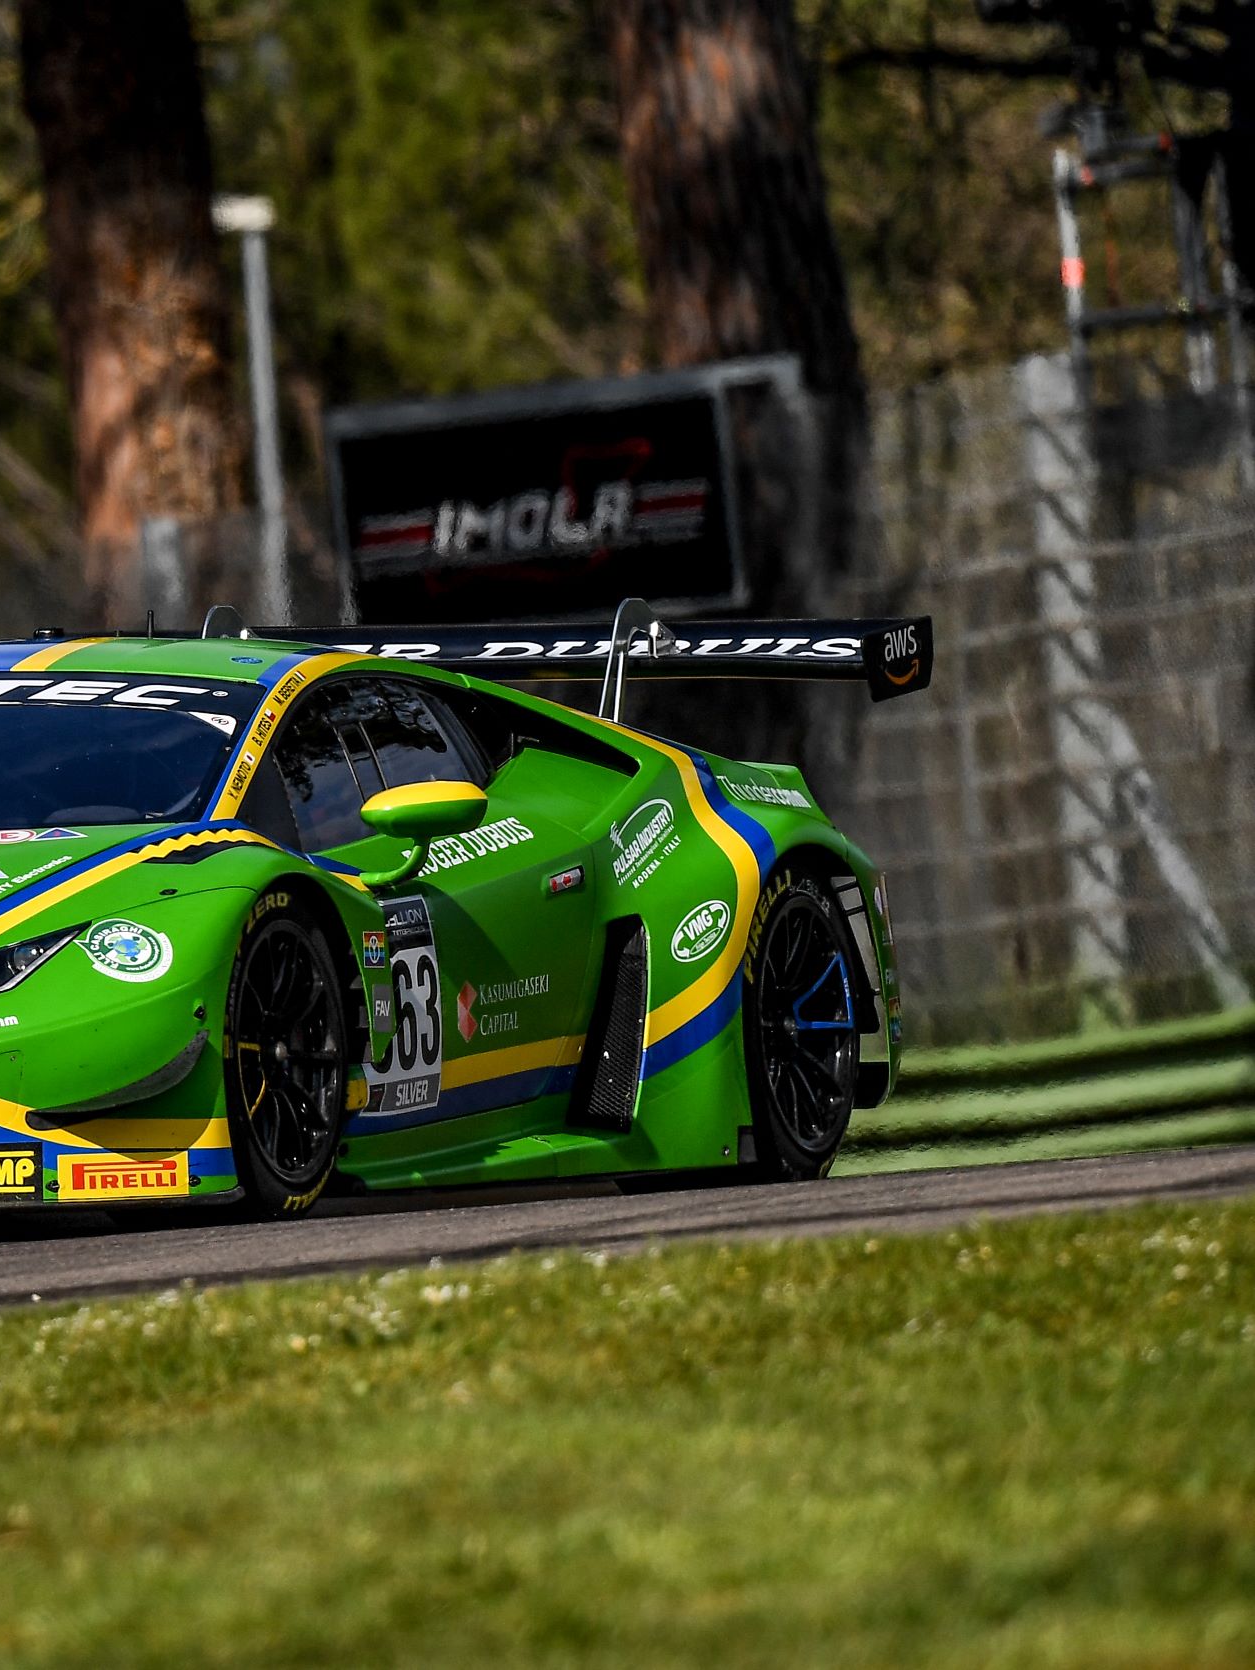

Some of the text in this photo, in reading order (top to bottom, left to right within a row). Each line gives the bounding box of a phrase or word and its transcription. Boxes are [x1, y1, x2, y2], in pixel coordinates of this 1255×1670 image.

[434, 481, 633, 556] IMOLA
[884, 625, 917, 662] aws
[256, 717, 272, 740] HITES
[233, 761, 252, 796] NEMOTO
[459, 816, 534, 857] DUBUIS
[613, 806, 670, 879] PULSAR INDUSTRY
[632, 834, 682, 889] MODENA ITALY
[246, 892, 289, 934] ZERO
[683, 909, 713, 940] VMG
[743, 869, 792, 985] PIRELLI
[90, 925, 143, 951] CASIRAGHI
[479, 974, 549, 1006] KASUMIGASEKI
[371, 955, 440, 1074] 63
[375, 1000, 391, 1017] FAV
[480, 1011, 519, 1036] CAPITAL
[395, 1079, 428, 1107] SILVER
[72, 1160, 177, 1190] PIRELLI
